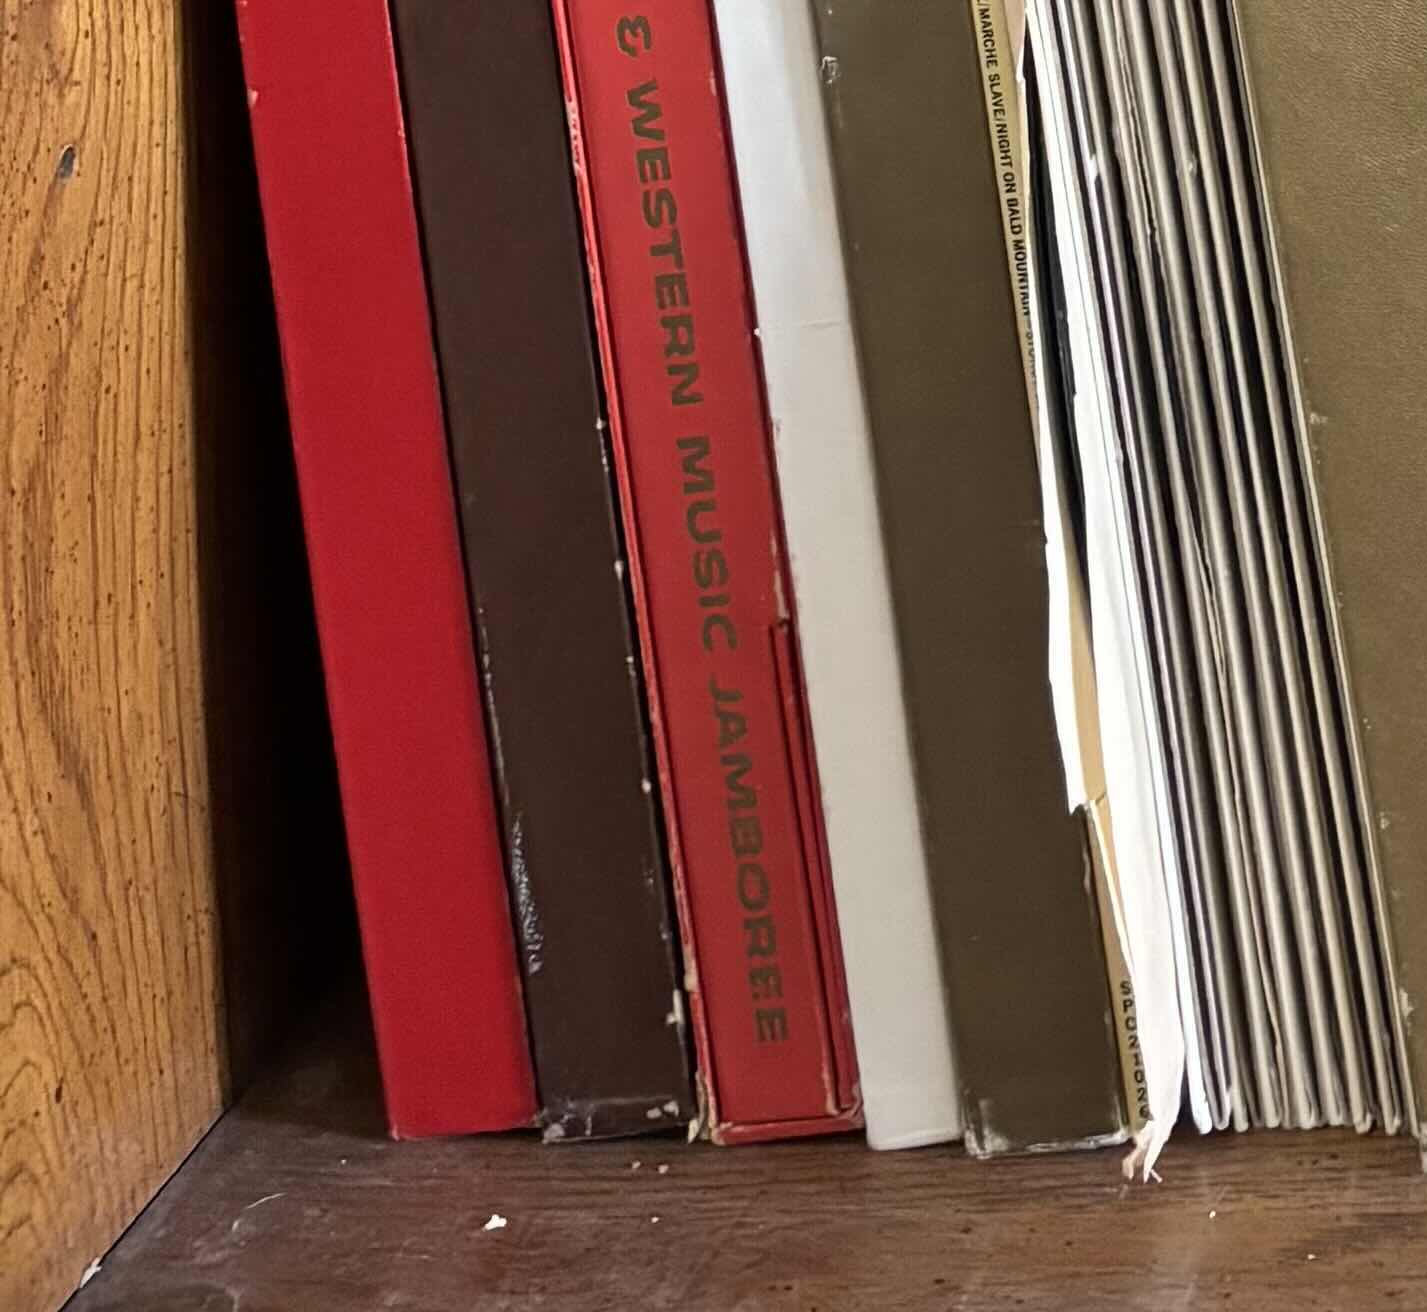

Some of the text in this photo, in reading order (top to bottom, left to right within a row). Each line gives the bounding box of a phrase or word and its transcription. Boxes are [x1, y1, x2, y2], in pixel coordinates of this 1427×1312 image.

[617, 15, 652, 59] &
[621, 81, 705, 407] WESTERN
[1004, 173, 1021, 194] ON
[1006, 198, 1023, 235] BALD
[676, 435, 738, 651] MUSIC
[708, 674, 789, 1043] JAMBOREE
